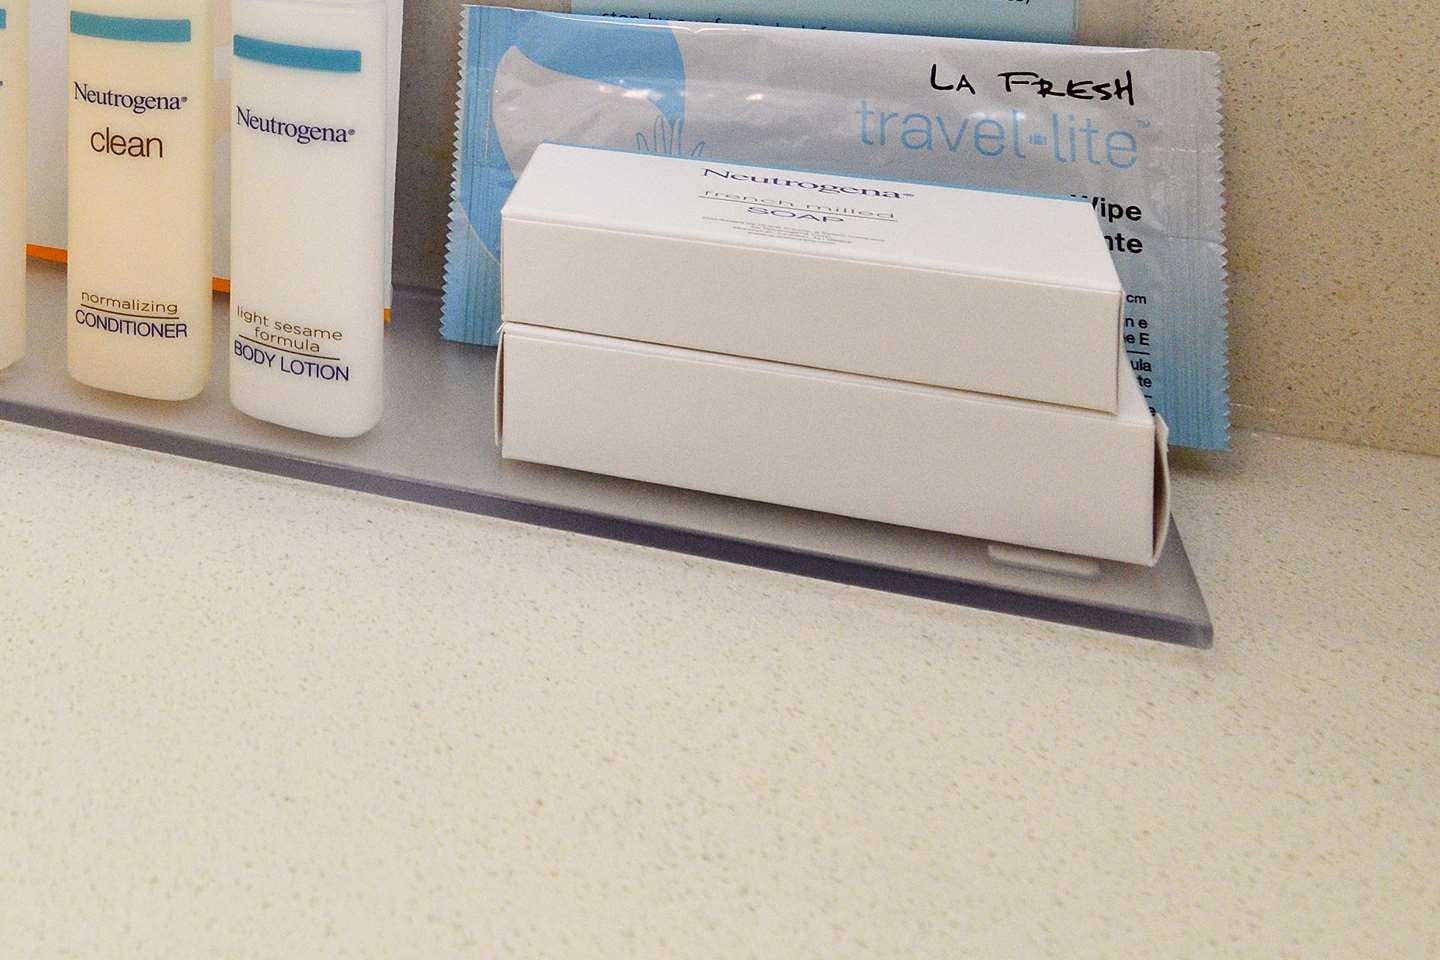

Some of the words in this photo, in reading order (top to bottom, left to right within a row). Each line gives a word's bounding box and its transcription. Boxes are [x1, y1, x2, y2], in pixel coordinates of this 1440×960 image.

[929, 63, 976, 96] LA
[997, 69, 1135, 106] FRESH
[90, 126, 163, 159] clean
[747, 206, 845, 223] SOAP
[80, 290, 178, 314] normalizing
[75, 307, 188, 339] CONDITIONER
[236, 305, 269, 329] light
[273, 317, 343, 342] sesame
[254, 325, 321, 353] formula
[234, 339, 277, 368] BODY
[280, 354, 350, 382] LOTION
